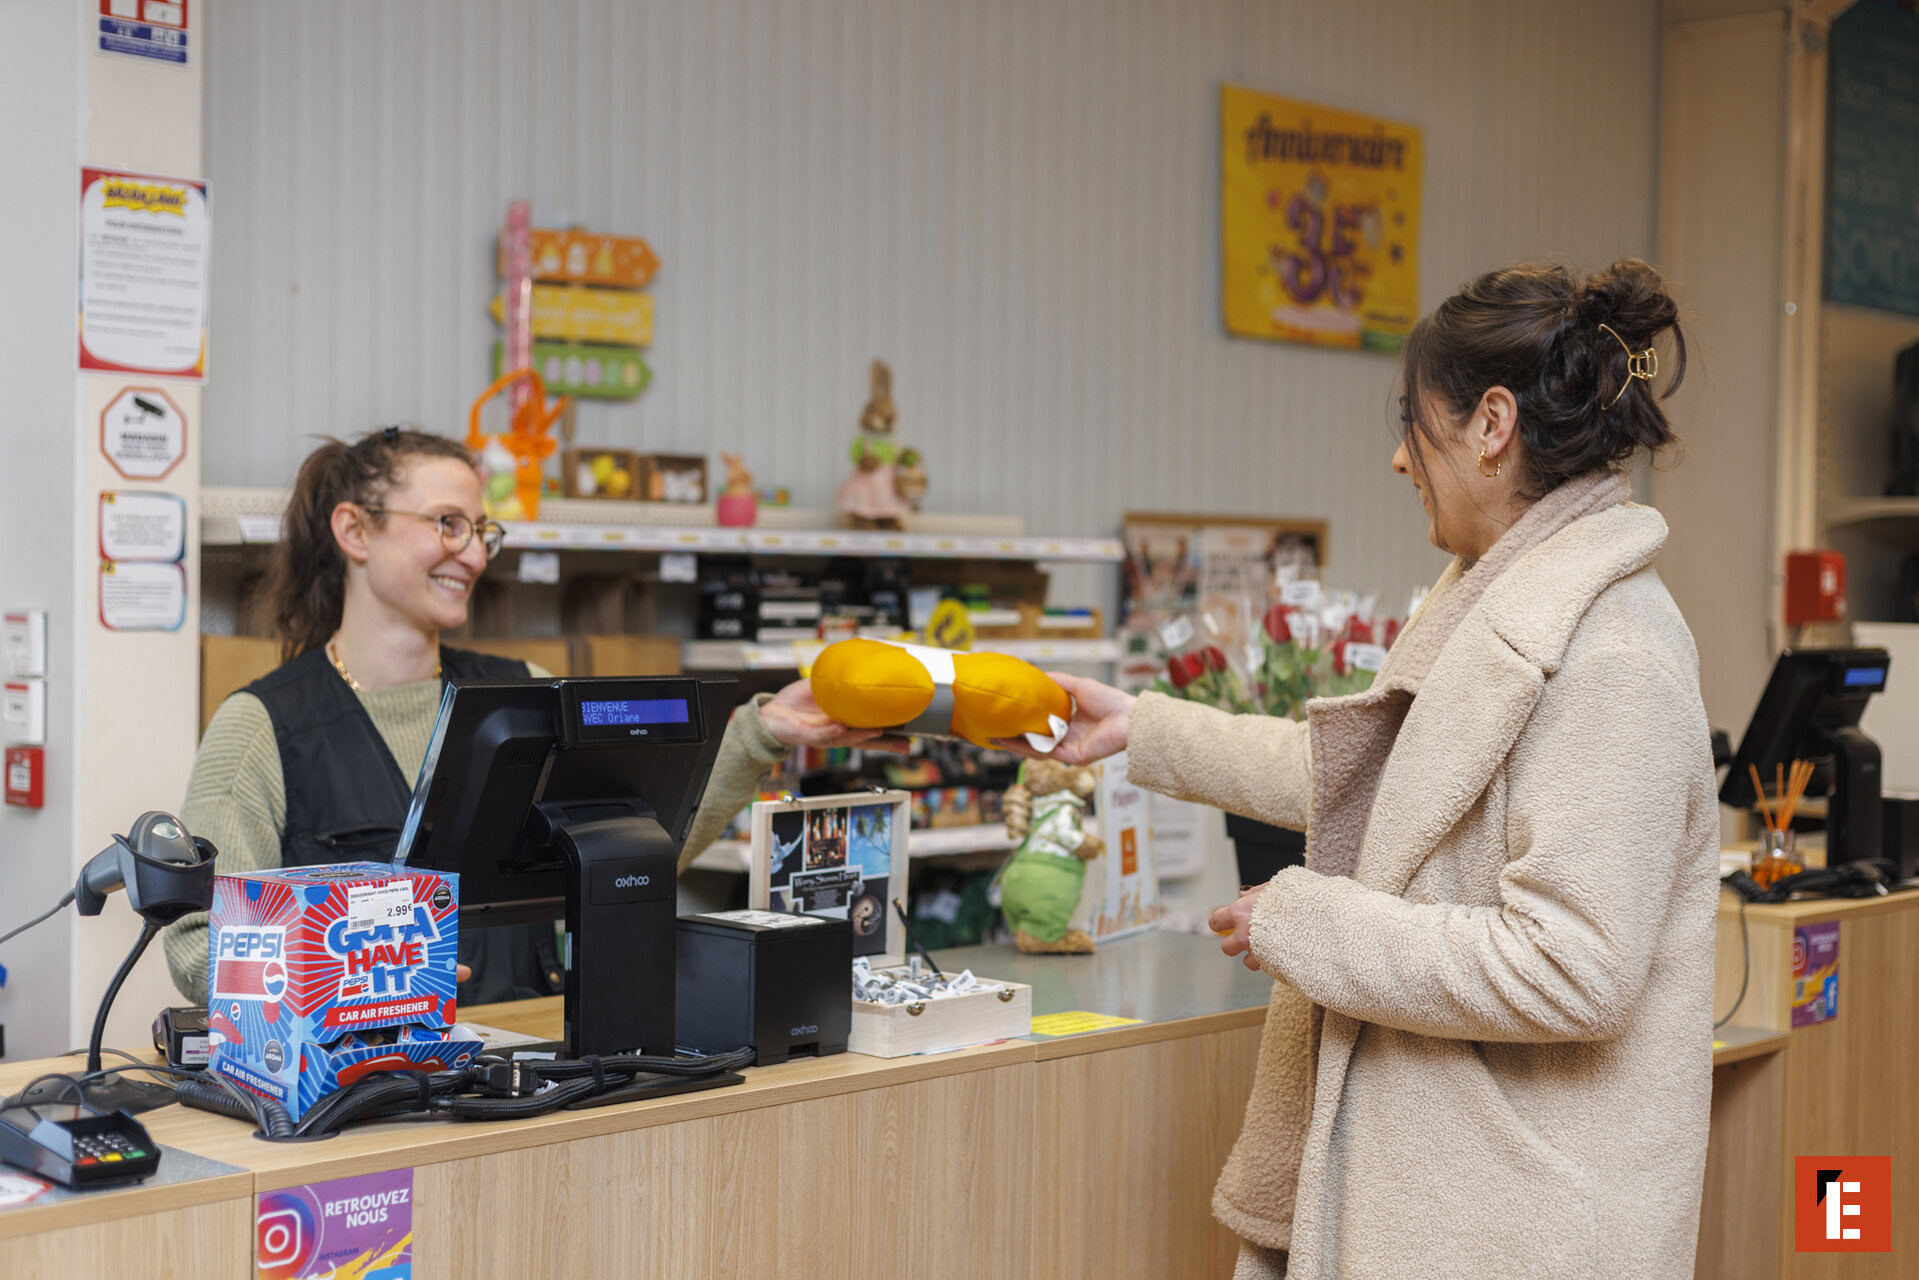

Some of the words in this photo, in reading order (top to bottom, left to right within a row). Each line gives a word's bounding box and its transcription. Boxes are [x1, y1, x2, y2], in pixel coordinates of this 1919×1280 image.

[581, 701, 629, 713] BIENVENUE
[607, 712, 640, 724] Oriane
[615, 874, 650, 888] oxhoo
[220, 932, 283, 958] PEPSI
[347, 941, 423, 975] HAVE
[343, 975, 368, 988] PEPSI
[372, 966, 411, 993] IT
[339, 1011, 359, 1022] CAR
[360, 1008, 377, 1020] AIR
[378, 1000, 429, 1017] FRESHENER
[222, 1061, 234, 1075] CAR
[234, 1068, 246, 1081] AIR
[246, 1073, 283, 1098] FRESHENER
[325, 1188, 409, 1217] RETROUVEZ
[346, 1207, 388, 1229] NOUS
